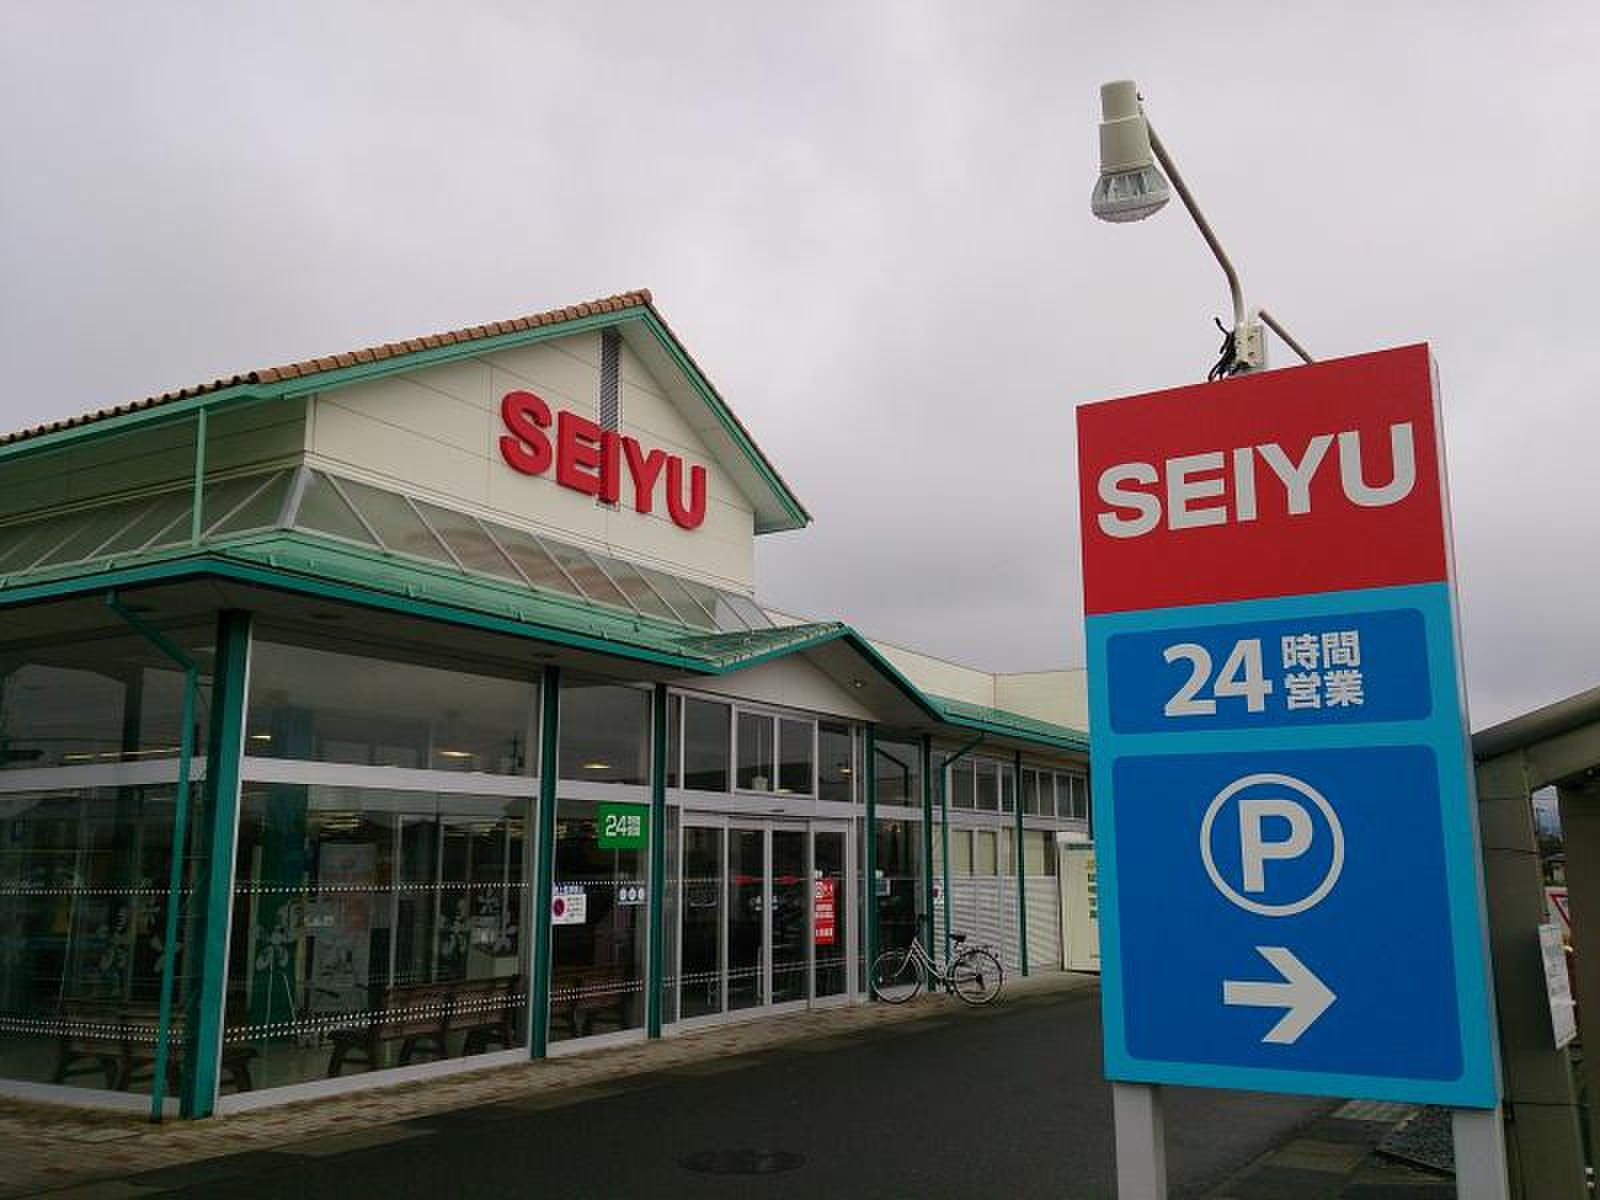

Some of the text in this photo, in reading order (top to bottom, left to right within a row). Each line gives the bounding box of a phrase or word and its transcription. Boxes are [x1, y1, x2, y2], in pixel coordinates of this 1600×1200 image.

[500, 390, 707, 530] SEIYU
[1097, 422, 1417, 538] SEIYU
[1162, 639, 1272, 717] 24
[1281, 630, 1361, 671] 時間
[1284, 669, 1364, 711] 営業
[606, 815, 627, 837] 24
[1238, 799, 1313, 893] P
